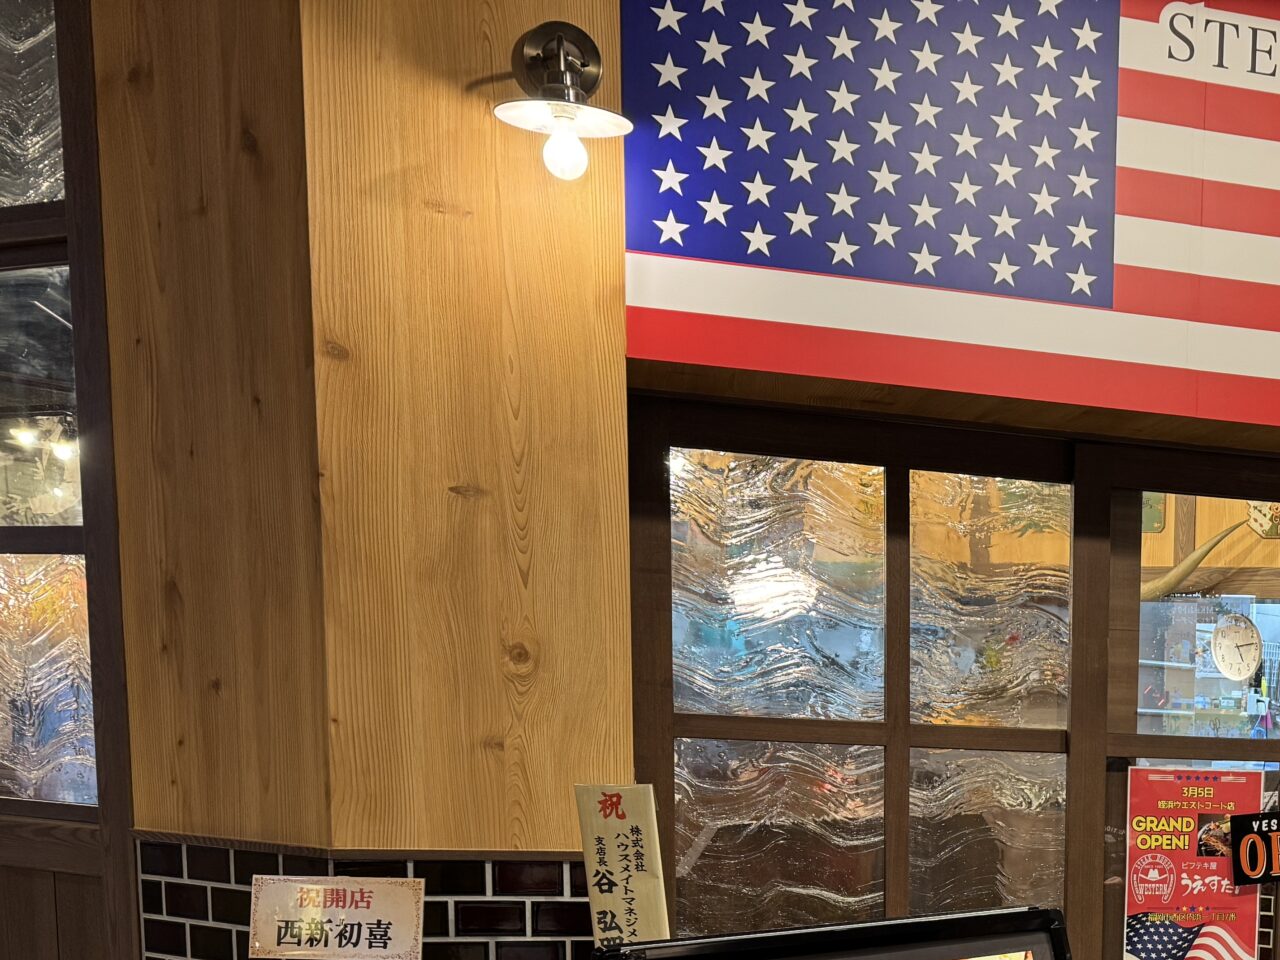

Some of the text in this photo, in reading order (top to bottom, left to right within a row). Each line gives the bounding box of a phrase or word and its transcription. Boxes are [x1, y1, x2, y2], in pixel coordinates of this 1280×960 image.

[1182, 787, 1214, 798] 3月5日
[598, 791, 627, 820] 祝
[1132, 816, 1195, 832] GRAND
[594, 836, 609, 867] 支店長
[629, 825, 647, 873] 株式会社
[1136, 833, 1189, 850] OPEN!
[1182, 862, 1218, 870] ビフテキ屋
[615, 832, 640, 944] ハウスメイトマネジメ
[1139, 884, 1169, 895] WESTERN
[1181, 873, 1240, 896] うえすた
[297, 887, 374, 910] 祝開店
[276, 917, 392, 949] 西新初喜
